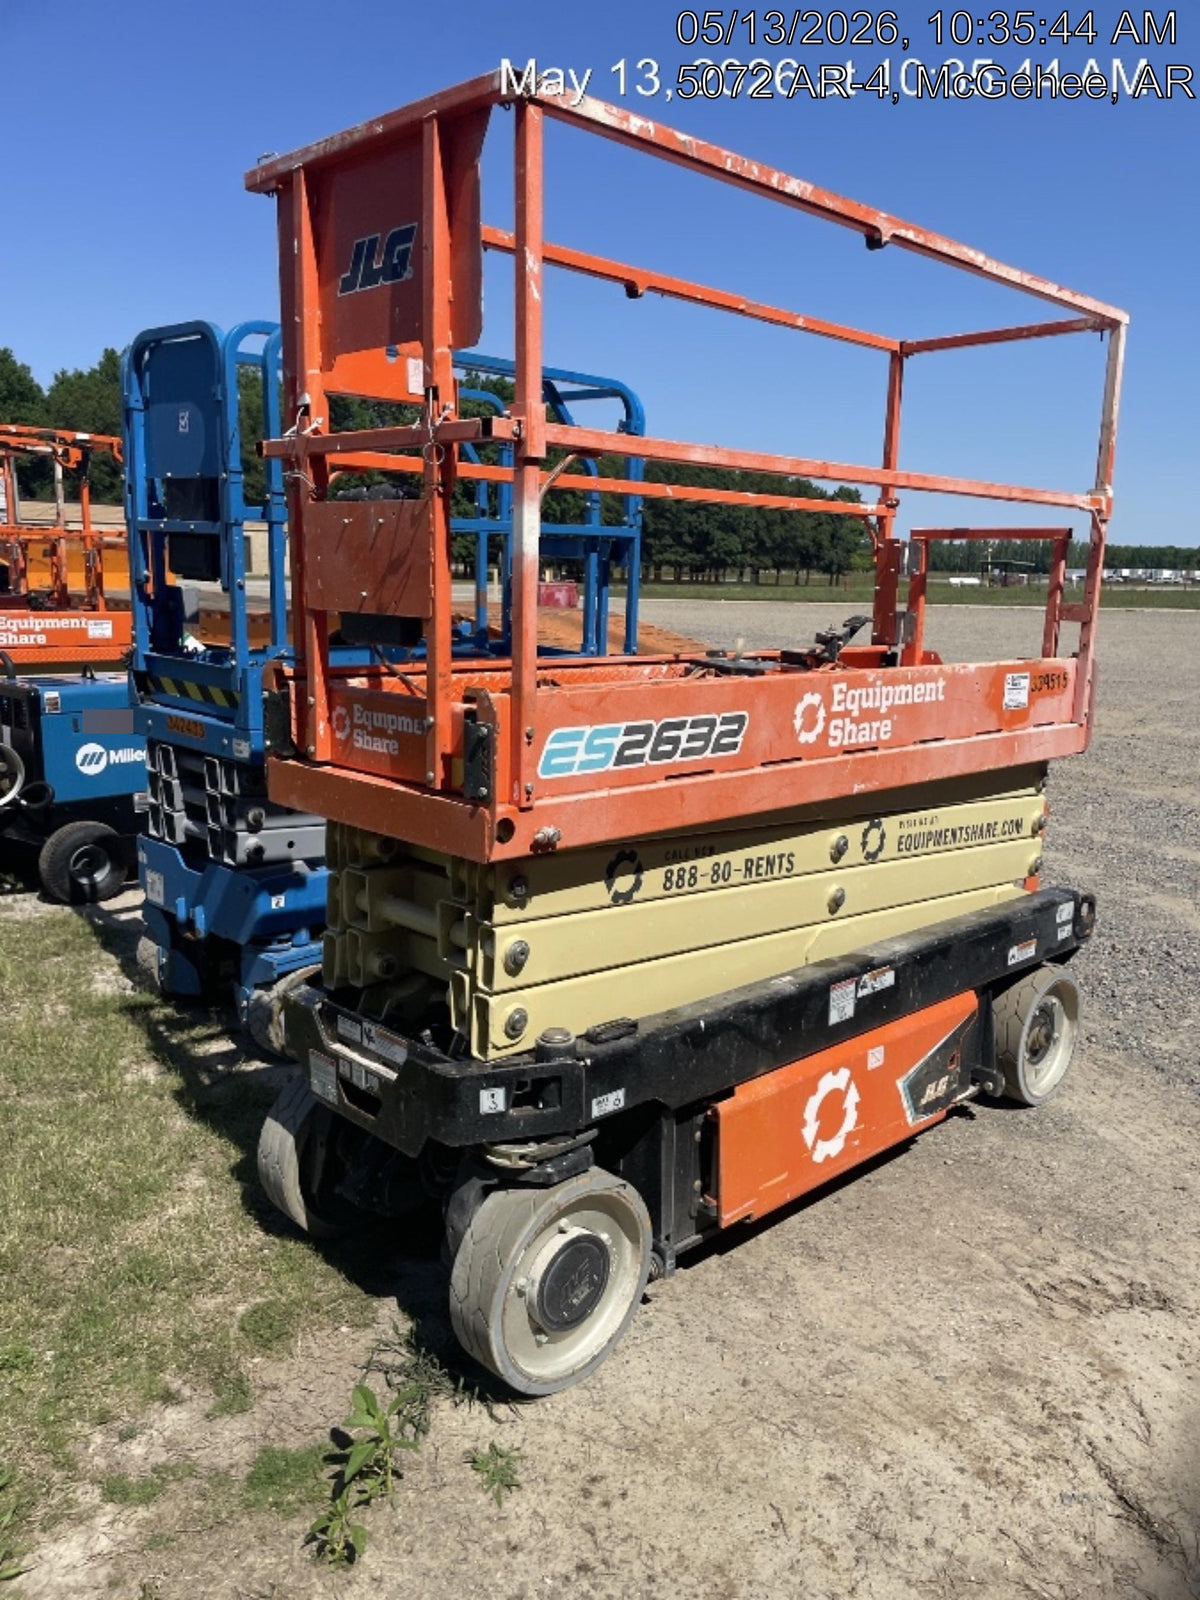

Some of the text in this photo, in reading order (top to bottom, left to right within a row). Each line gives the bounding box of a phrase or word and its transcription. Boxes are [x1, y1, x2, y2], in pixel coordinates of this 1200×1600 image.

[338, 222, 418, 297] JLG
[0, 616, 87, 632] Equipment
[0, 633, 46, 645] Share
[831, 677, 946, 717] Equipment
[353, 728, 399, 755] Share
[538, 711, 748, 779] ES2632
[828, 718, 892, 747] Share
[898, 818, 1024, 852] EQUIPMENTSHARE.COM
[663, 852, 795, 891] 888-80-RENTS
